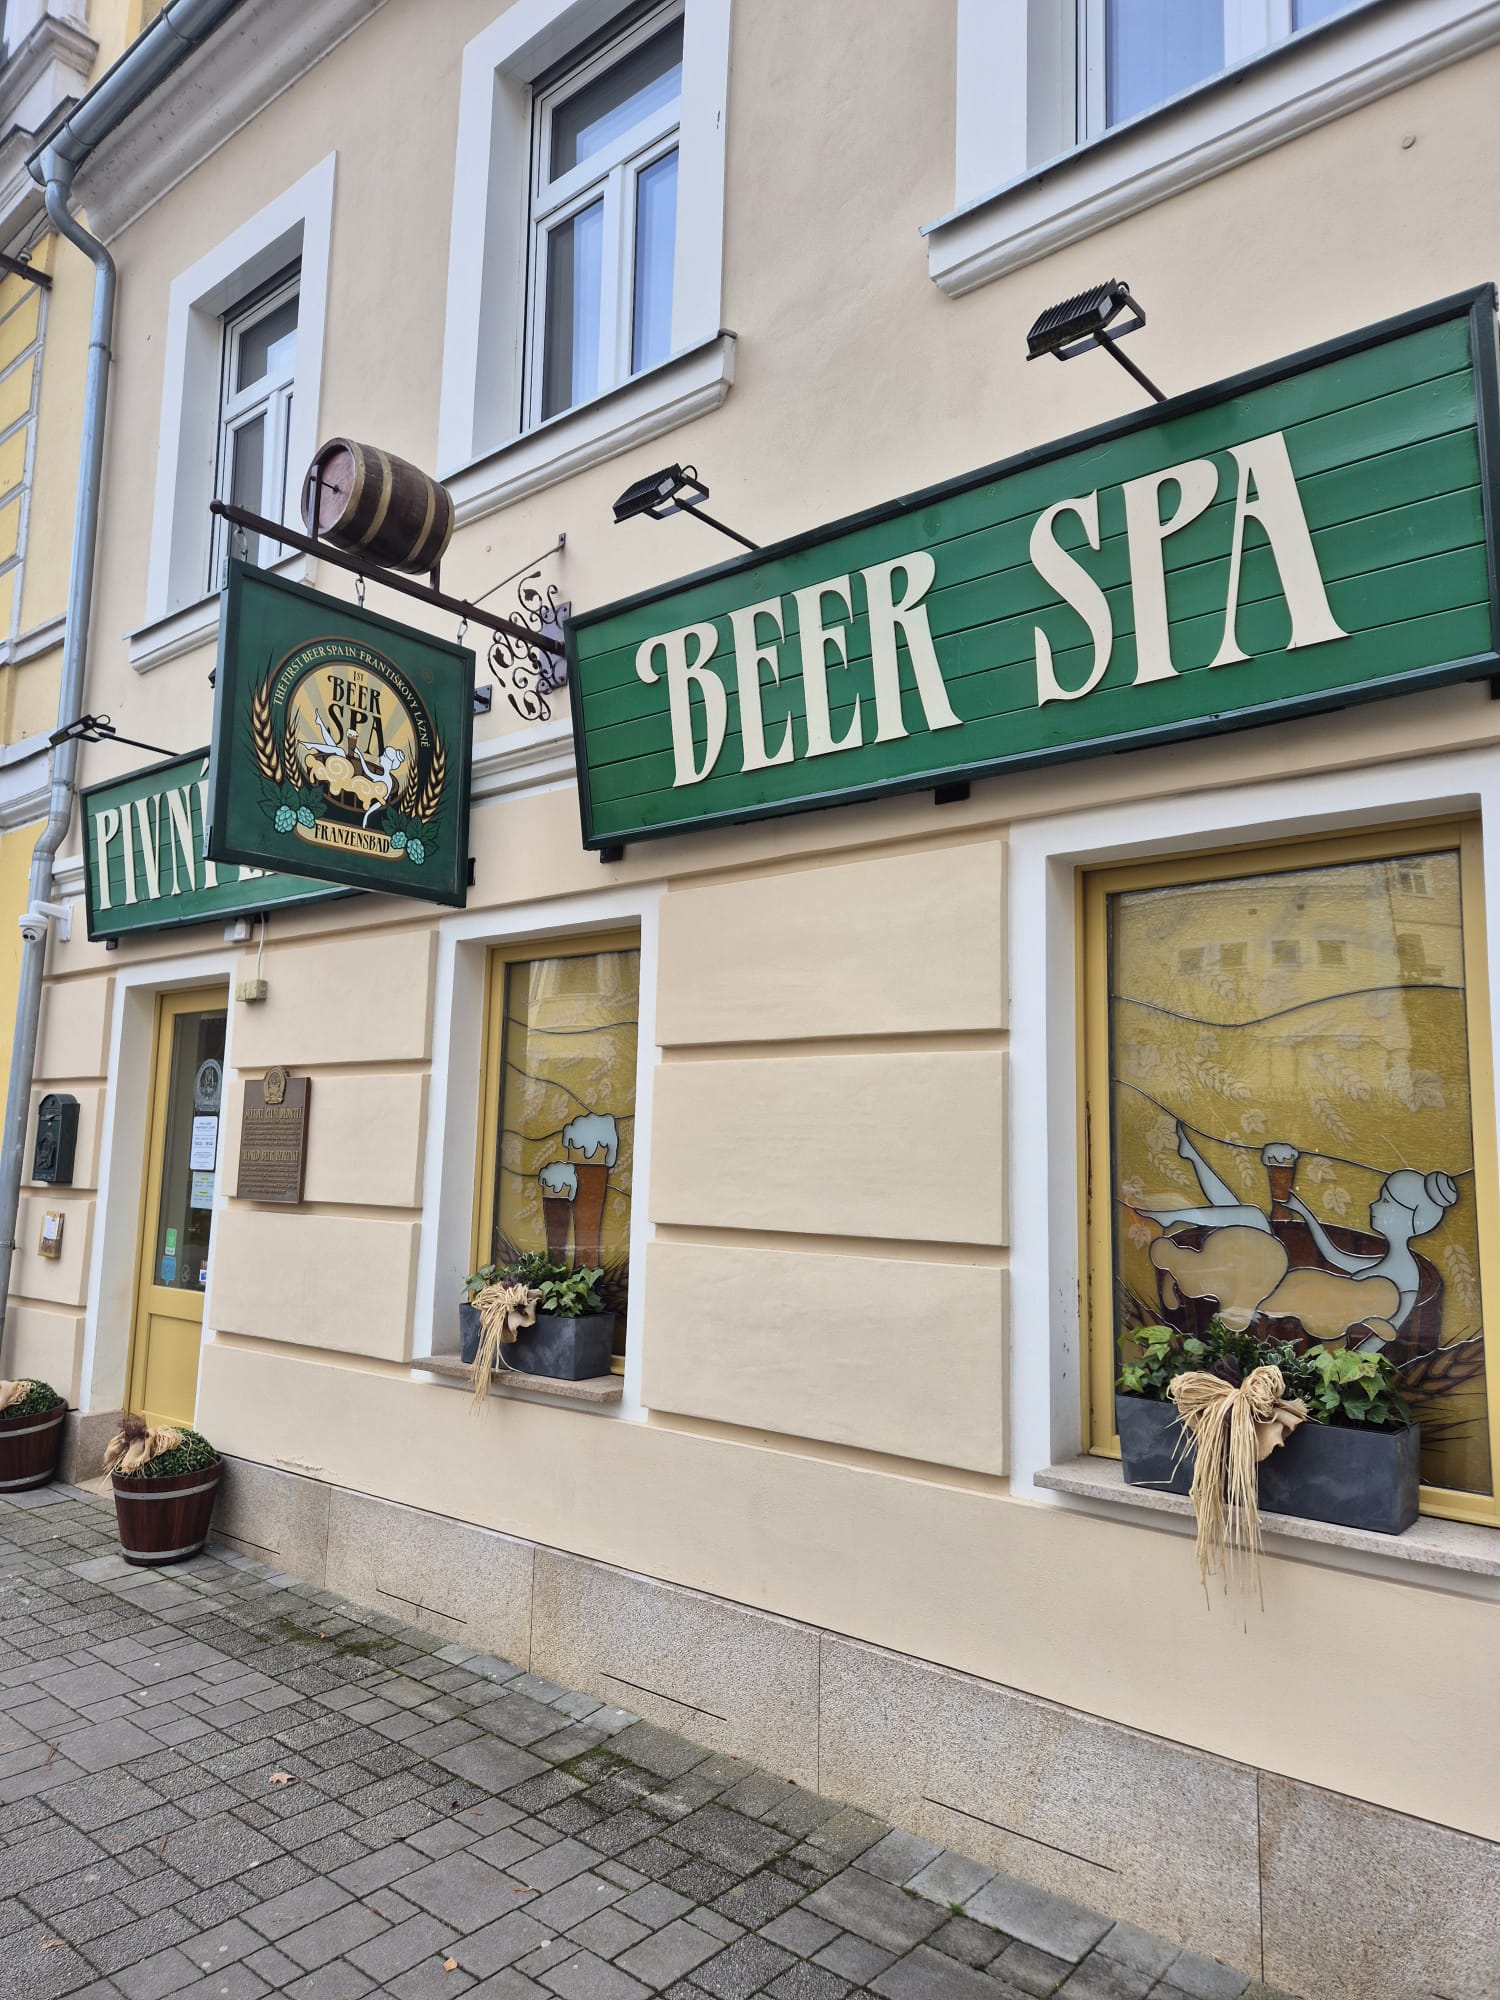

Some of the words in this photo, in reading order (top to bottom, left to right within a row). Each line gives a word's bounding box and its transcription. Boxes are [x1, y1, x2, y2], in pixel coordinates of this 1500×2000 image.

[634, 550, 964, 788] BEER
[1029, 430, 1353, 708] SPA
[273, 682, 287, 704] THE
[280, 657, 304, 685] FIRST
[302, 646, 326, 663] BEER
[359, 650, 418, 708] FRANTIŠKOVY
[327, 675, 382, 716] BEER
[327, 703, 385, 757] SPA
[313, 823, 391, 854] FRANZENSBAD
